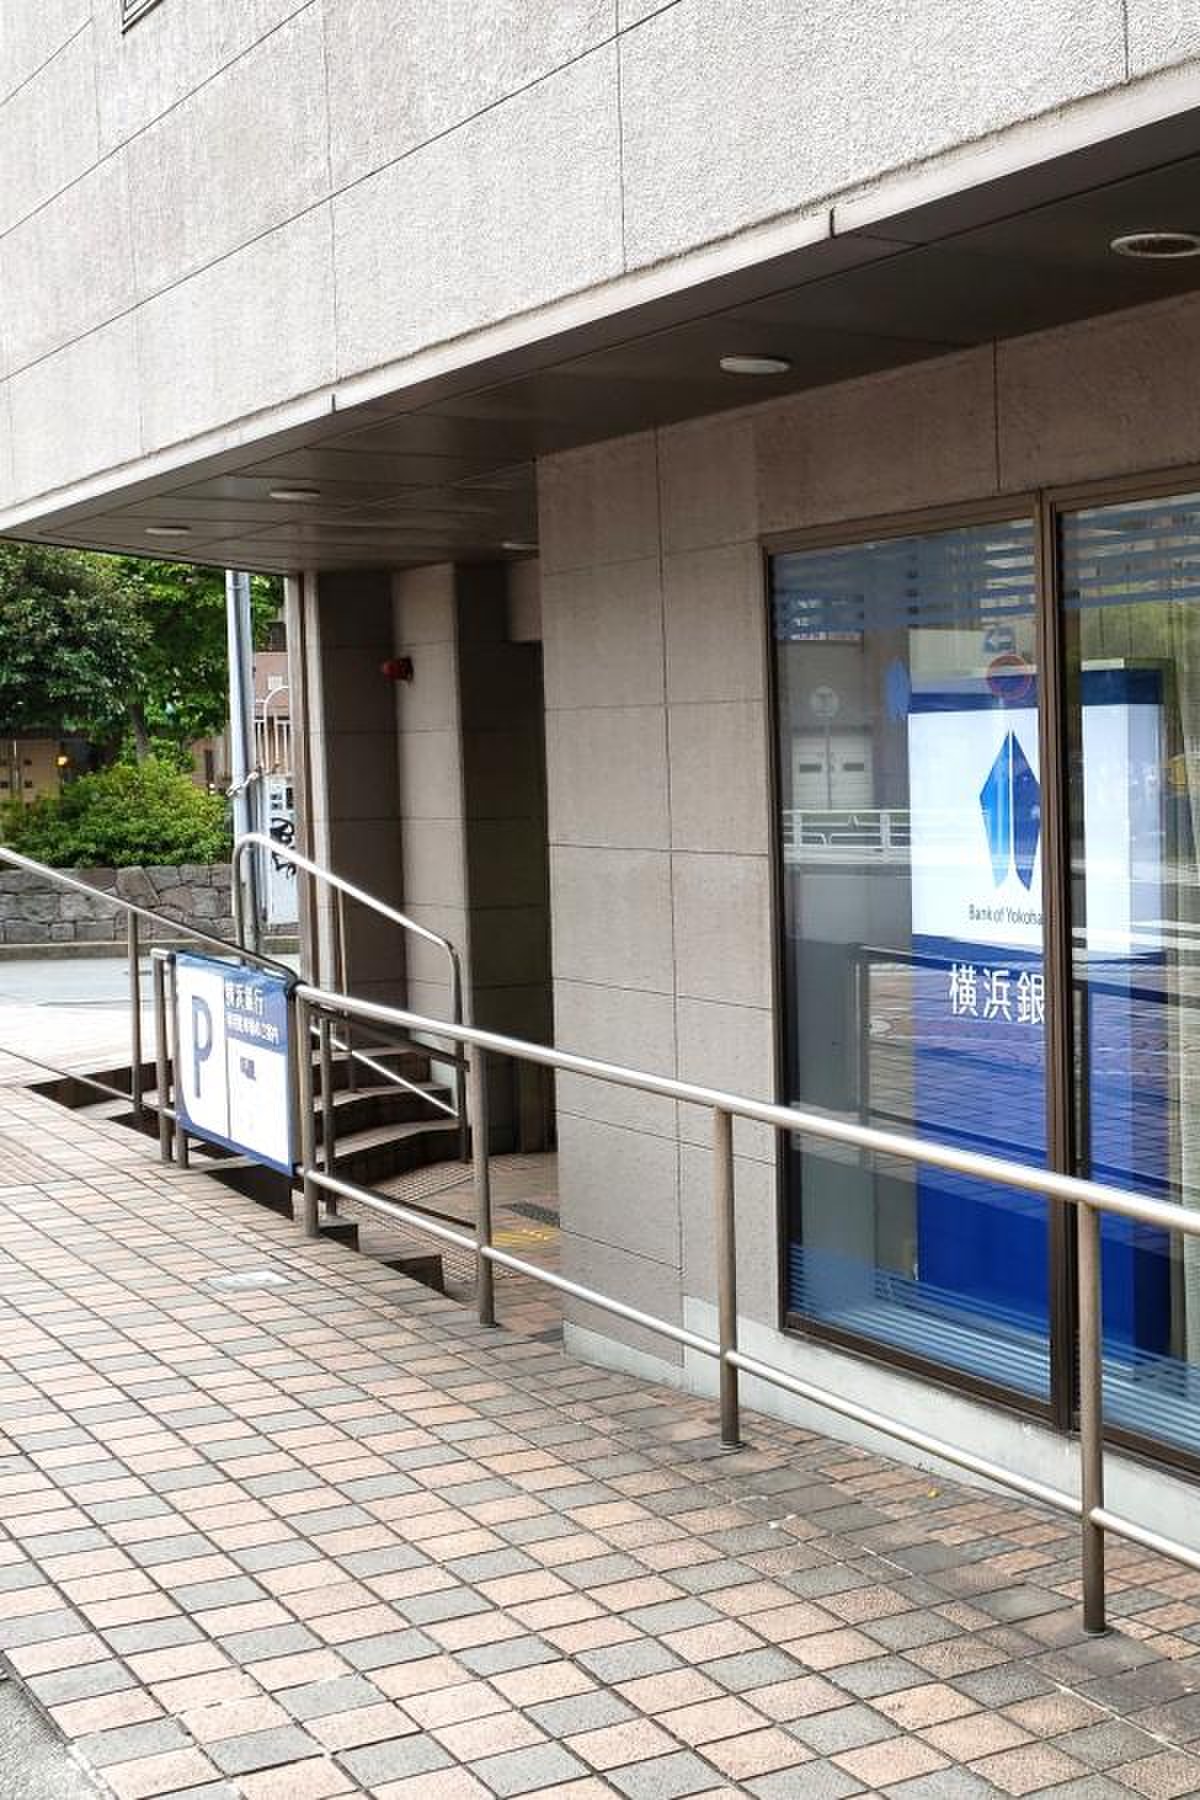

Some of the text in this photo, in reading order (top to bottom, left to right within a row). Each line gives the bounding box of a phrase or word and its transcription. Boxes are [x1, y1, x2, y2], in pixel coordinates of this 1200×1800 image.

[969, 904, 993, 921] Bank
[993, 906, 1004, 924] of
[949, 963, 1045, 1024] 横浜銀
[191, 995, 212, 1099] P
